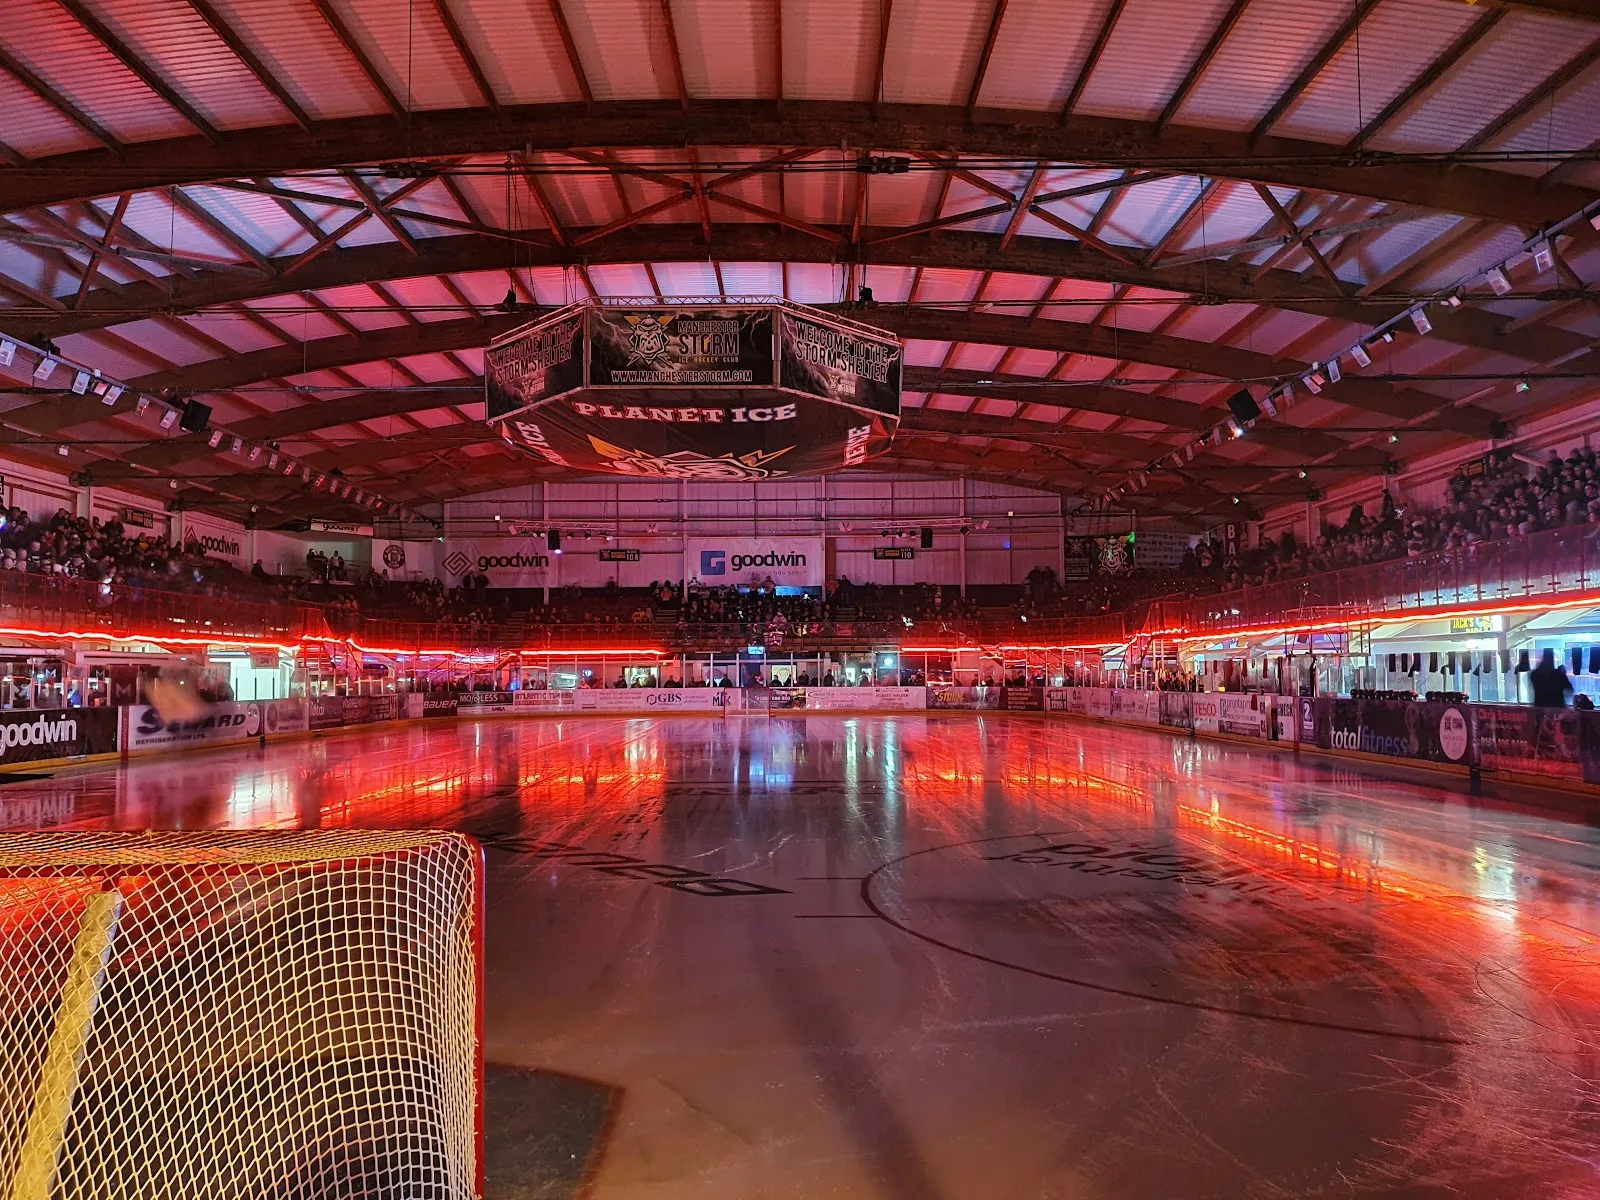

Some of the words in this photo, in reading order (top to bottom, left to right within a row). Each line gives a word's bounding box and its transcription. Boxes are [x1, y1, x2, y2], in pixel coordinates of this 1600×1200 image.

[677, 320, 740, 333] MANCHESTER
[496, 336, 540, 368] WELCOME
[541, 329, 555, 349] TO
[555, 321, 573, 345] THE
[678, 333, 740, 356] STORM
[796, 321, 850, 353] WELCOME
[853, 339, 868, 359] TO
[869, 344, 888, 363] THE
[496, 358, 530, 385] STORM
[531, 341, 573, 375] SHELTER
[795, 340, 838, 369] STORM
[839, 353, 888, 383] SHELTER
[610, 370, 753, 383] WWW.MANCHESTERSTORM.COM
[572, 401, 725, 424] PLANET
[731, 402, 797, 423] ICE
[201, 535, 240, 556] goodwin
[478, 552, 549, 572] goodwin
[626, 553, 639, 561] 108
[731, 550, 807, 572] goodwin
[658, 692, 682, 703] GBS
[1194, 702, 1217, 717] TESCO
